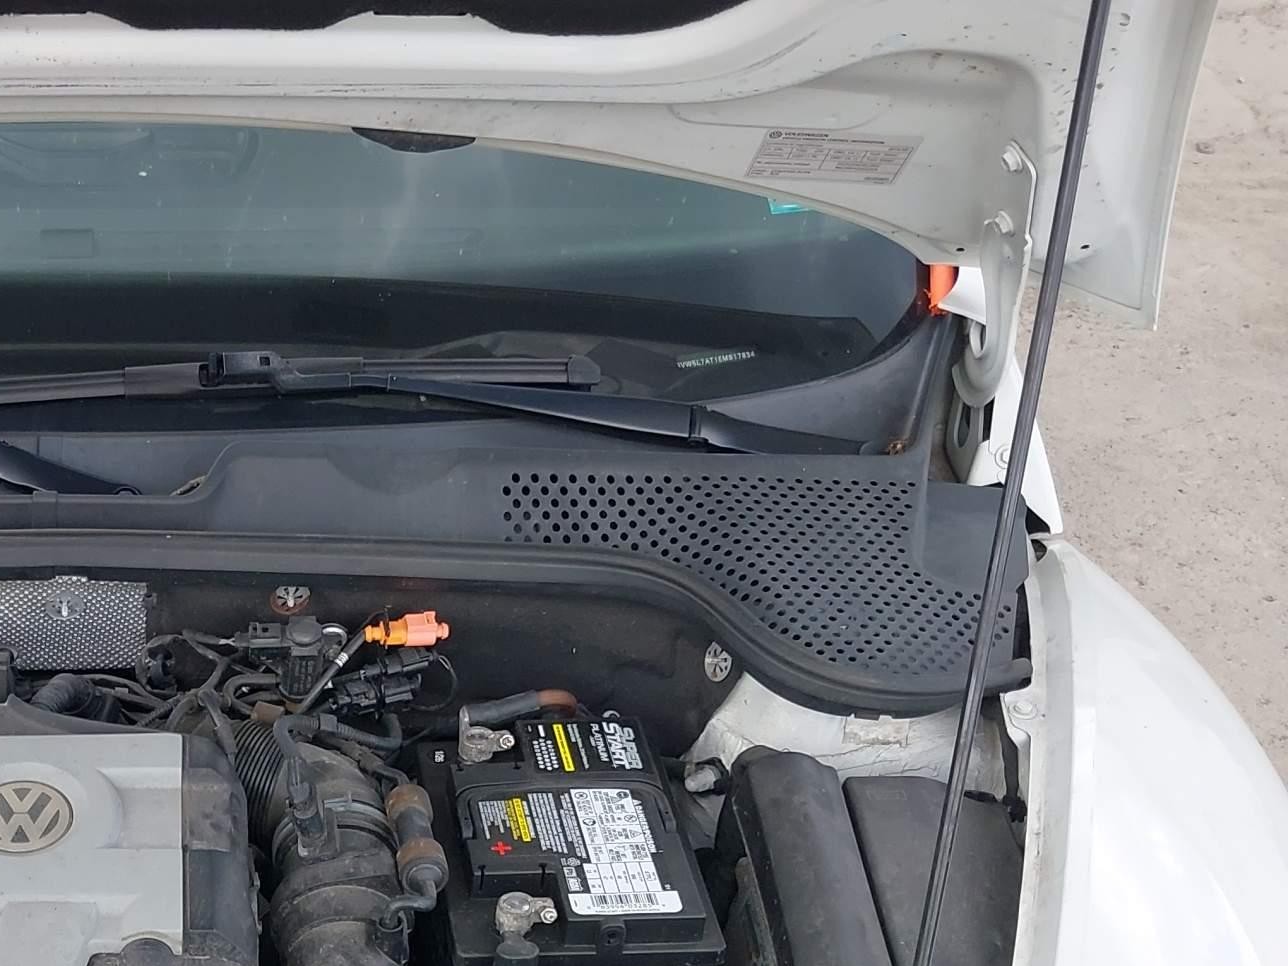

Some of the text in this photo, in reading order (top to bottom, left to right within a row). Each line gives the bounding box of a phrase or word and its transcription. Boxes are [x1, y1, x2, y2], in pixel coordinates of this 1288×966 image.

[590, 723, 610, 762] PLATINUM
[602, 722, 631, 770] START
[622, 727, 643, 769] SUPER
